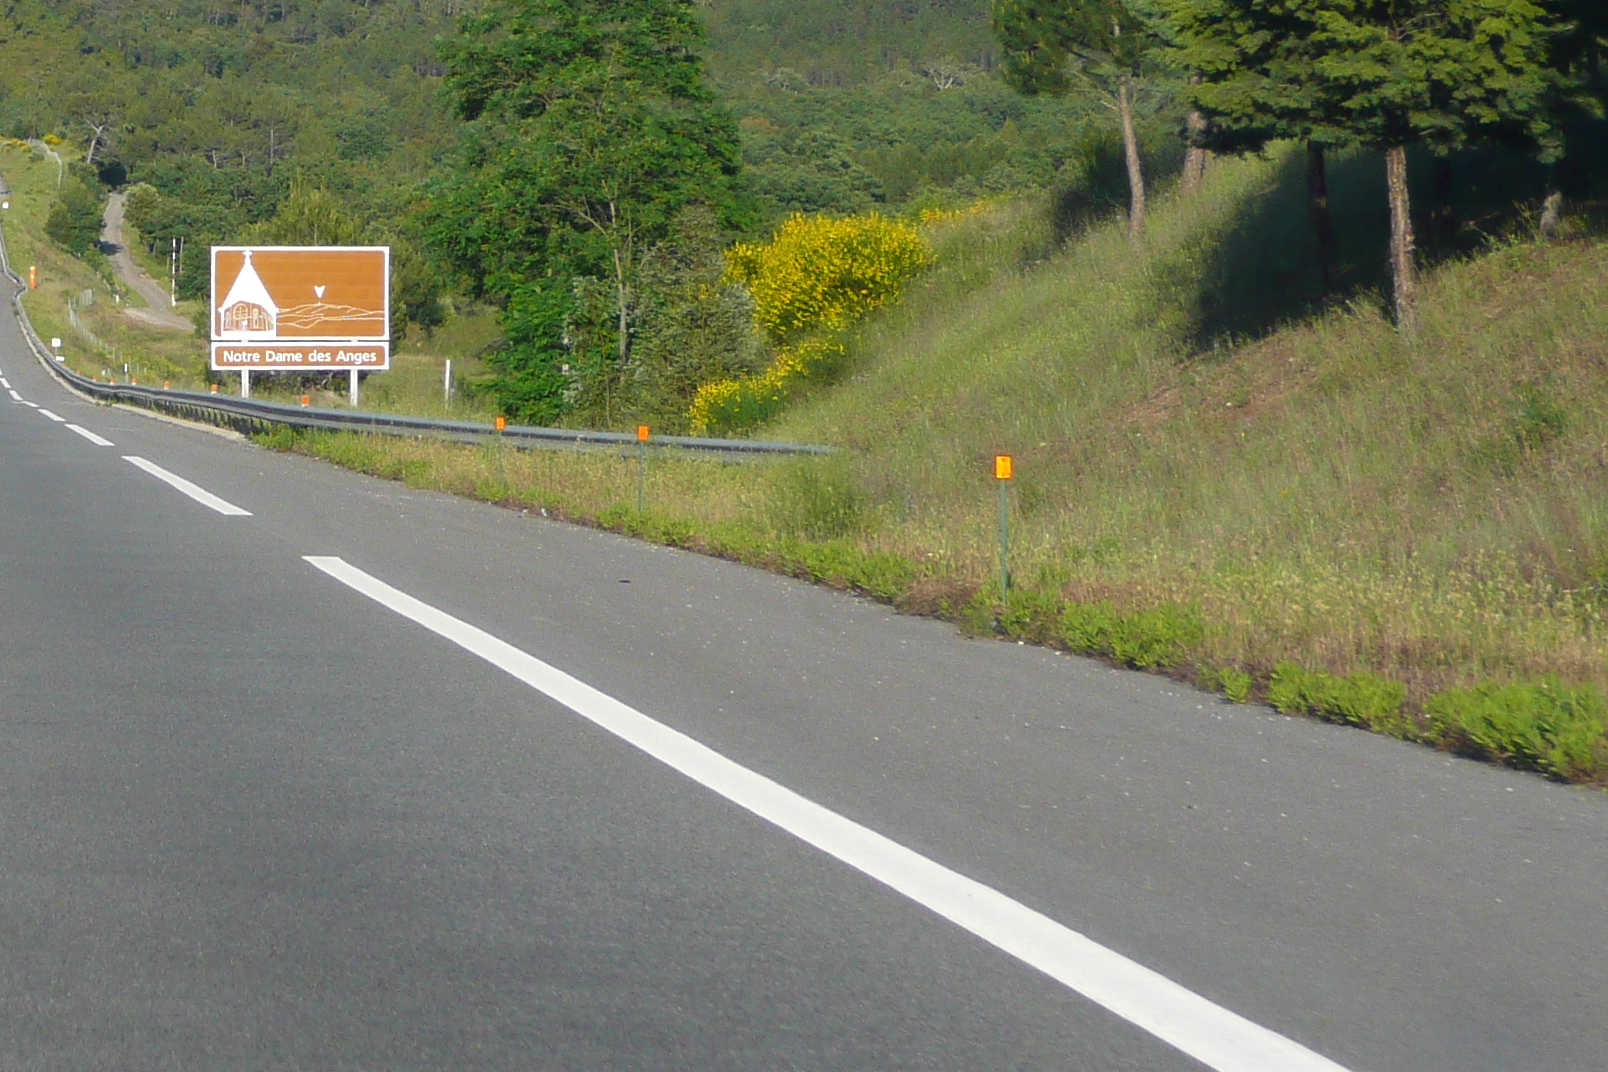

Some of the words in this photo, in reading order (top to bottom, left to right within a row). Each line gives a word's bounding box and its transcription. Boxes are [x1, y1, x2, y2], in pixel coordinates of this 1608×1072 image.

[223, 350, 260, 362] Notre
[265, 350, 302, 362] Dame
[308, 349, 331, 362] des
[336, 350, 377, 365] Anges
